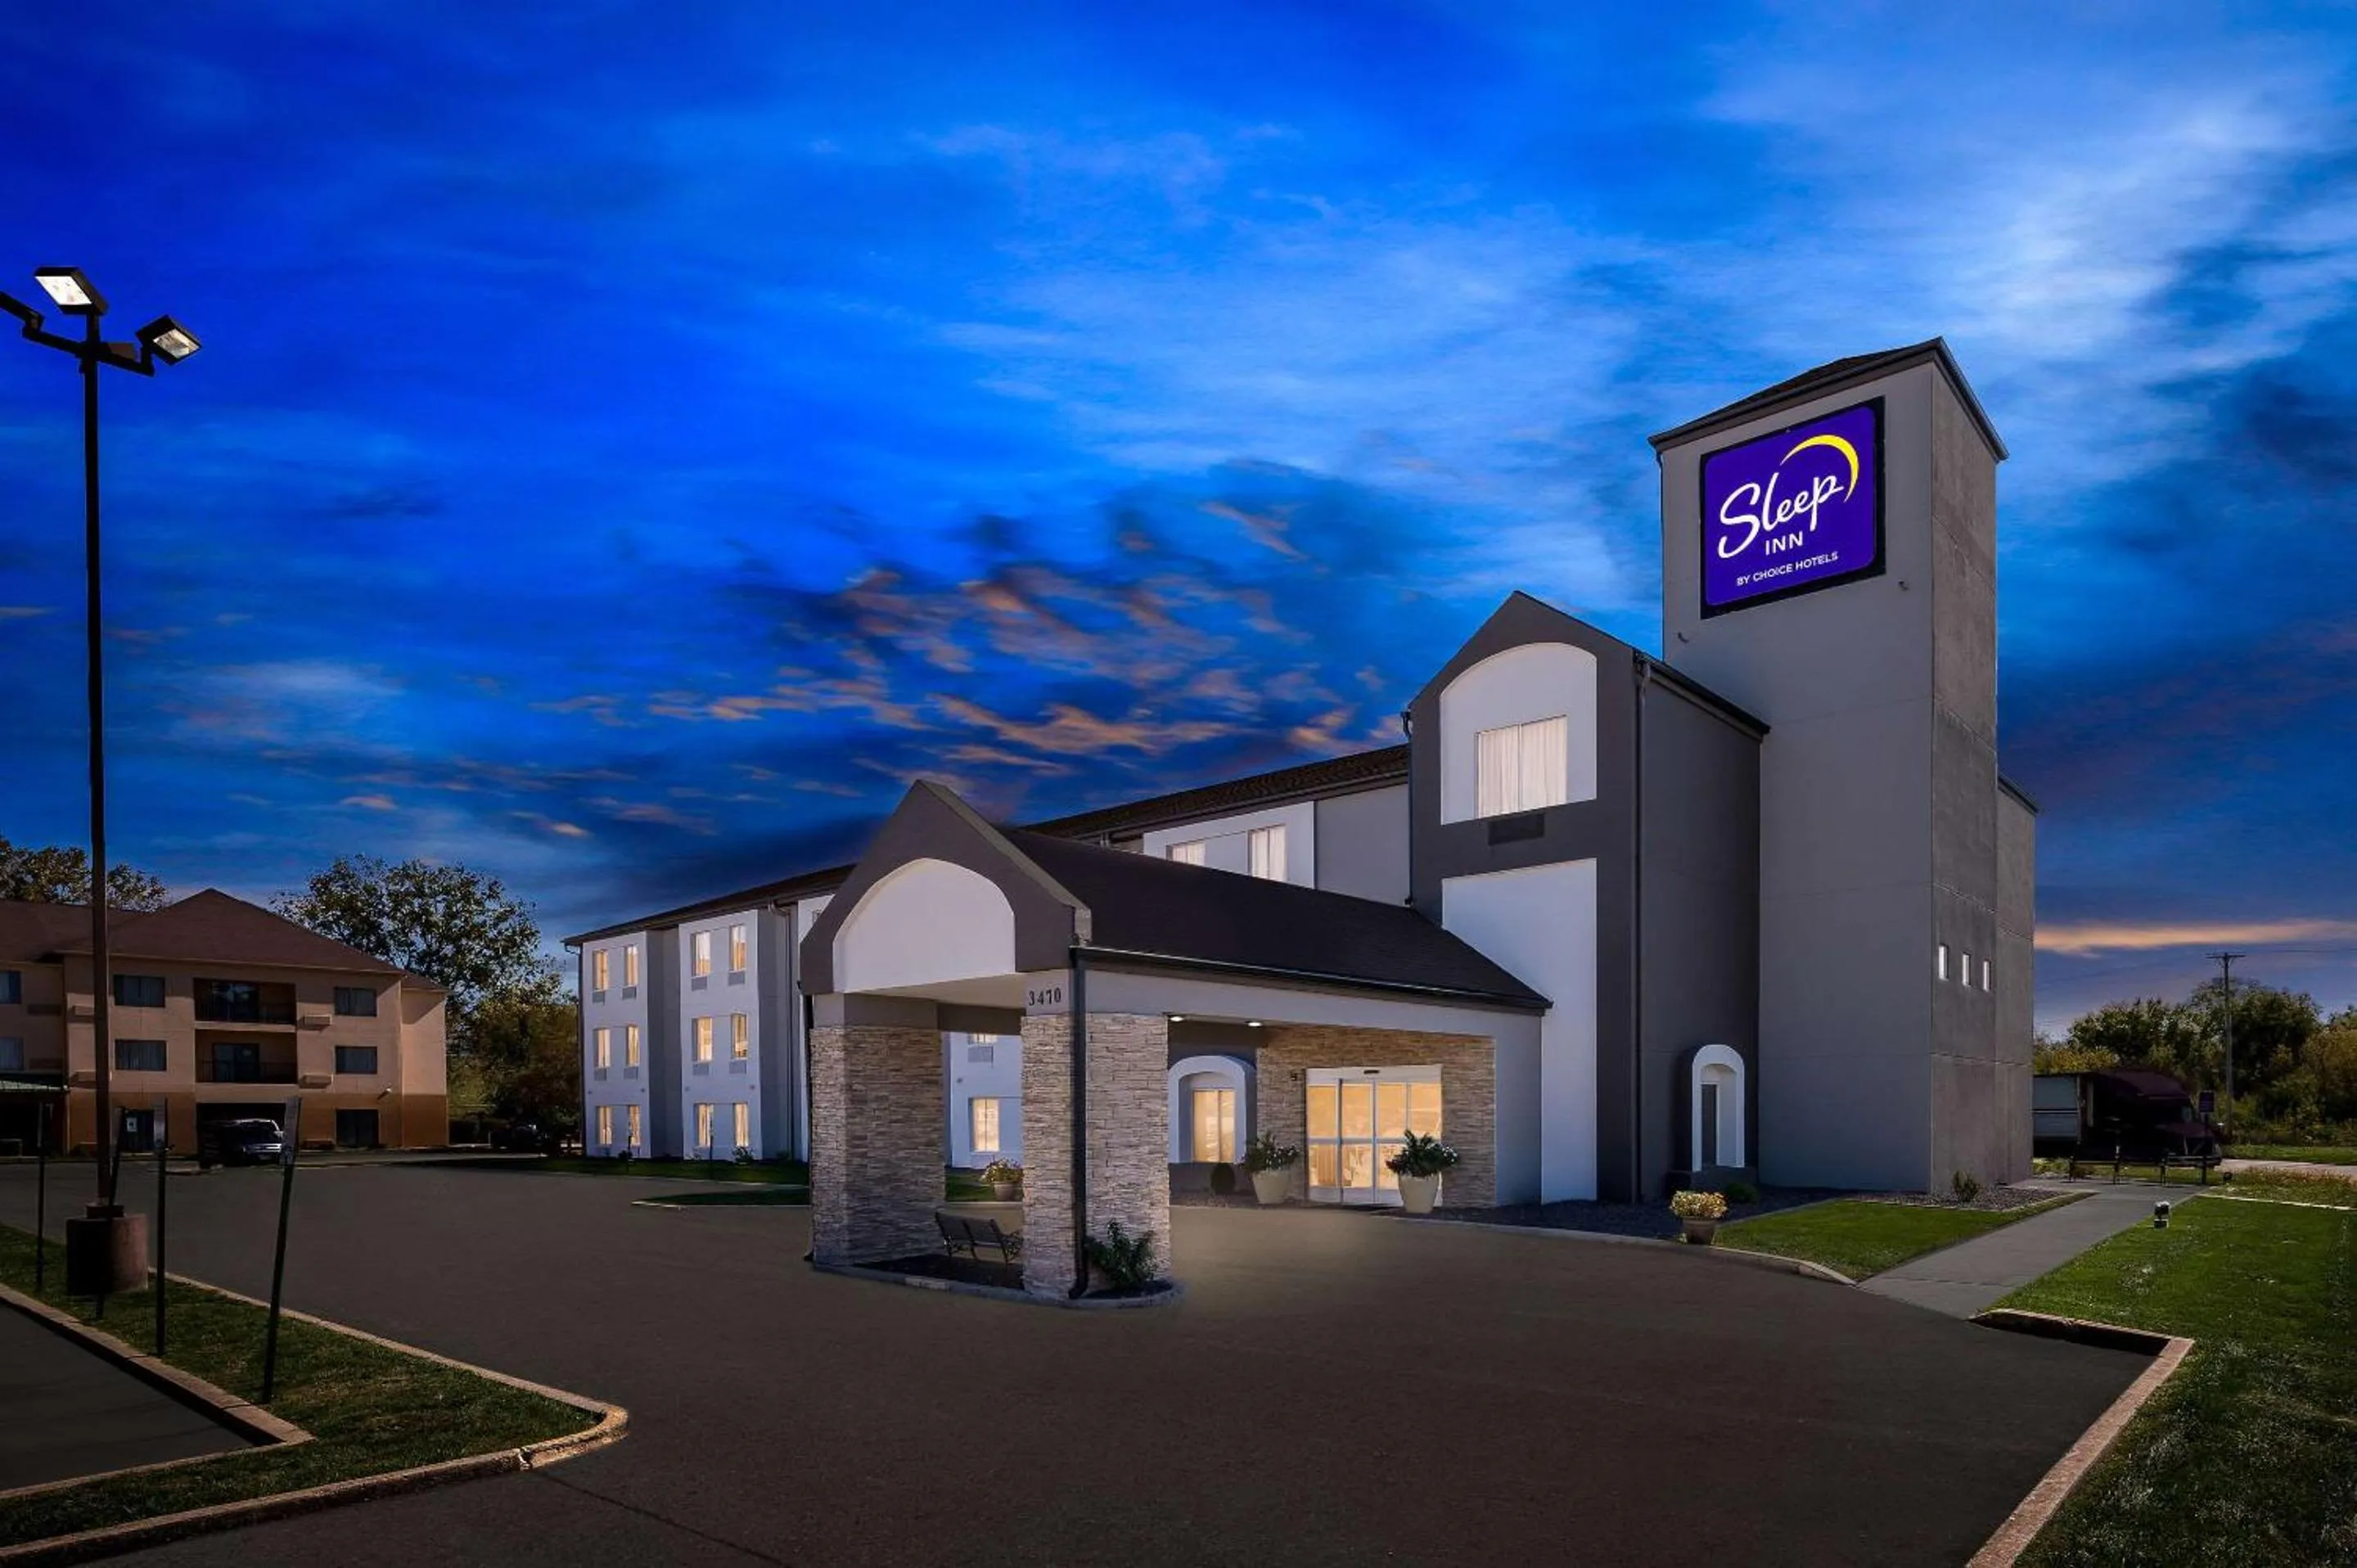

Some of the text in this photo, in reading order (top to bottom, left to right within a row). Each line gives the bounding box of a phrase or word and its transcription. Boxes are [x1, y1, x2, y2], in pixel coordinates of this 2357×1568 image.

[1718, 472, 1844, 559] Sleep
[1765, 530, 1804, 556] INN
[1736, 551, 1839, 587] BY CHOICE HOTELS
[1028, 987, 1061, 1007] 3470
